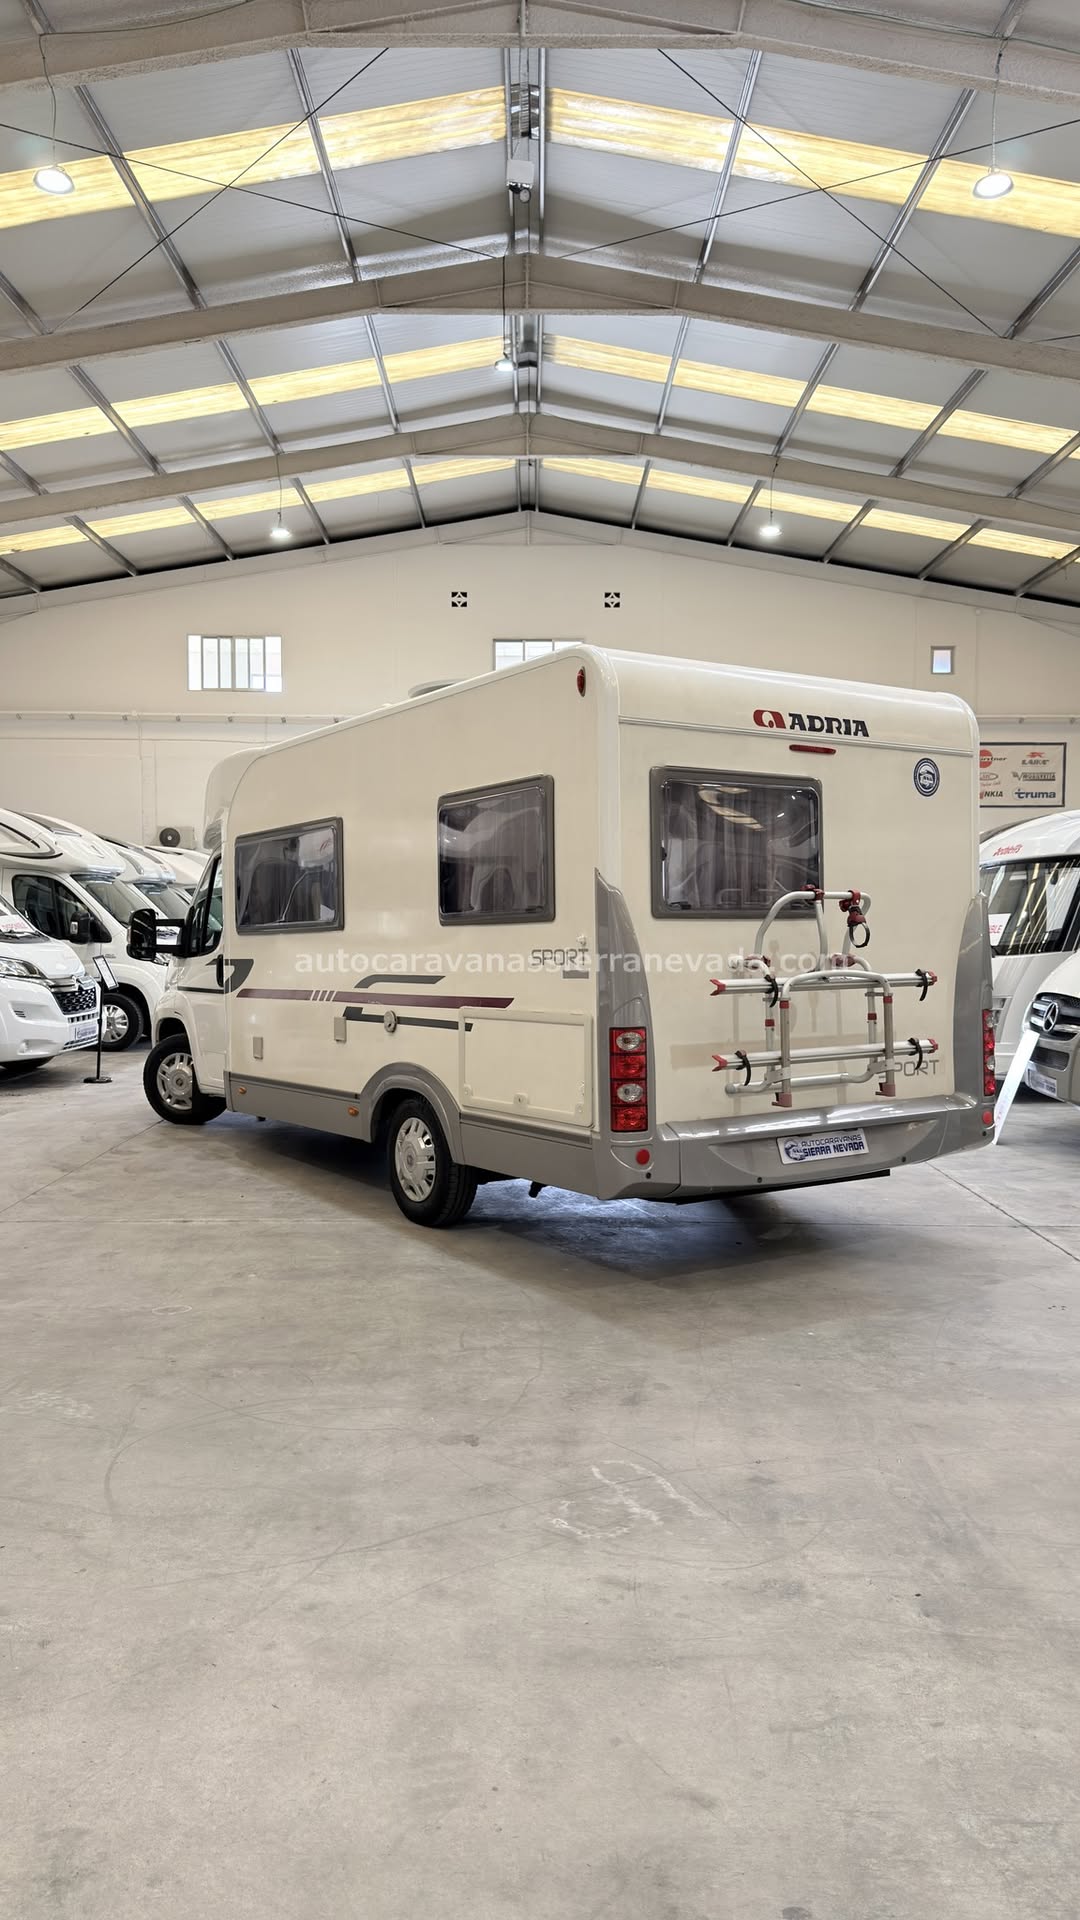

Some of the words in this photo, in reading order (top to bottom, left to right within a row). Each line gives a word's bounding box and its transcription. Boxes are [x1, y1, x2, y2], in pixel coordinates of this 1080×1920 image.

[788, 712, 870, 737] ADRIA
[1014, 788, 1056, 799] truma
[531, 948, 589, 966] SPORT
[882, 1059, 940, 1078] PORT
[801, 1133, 863, 1147] AUTOCARAVANAS
[803, 1145, 831, 1157] SIERRA
[833, 1141, 865, 1153] NEVADA
